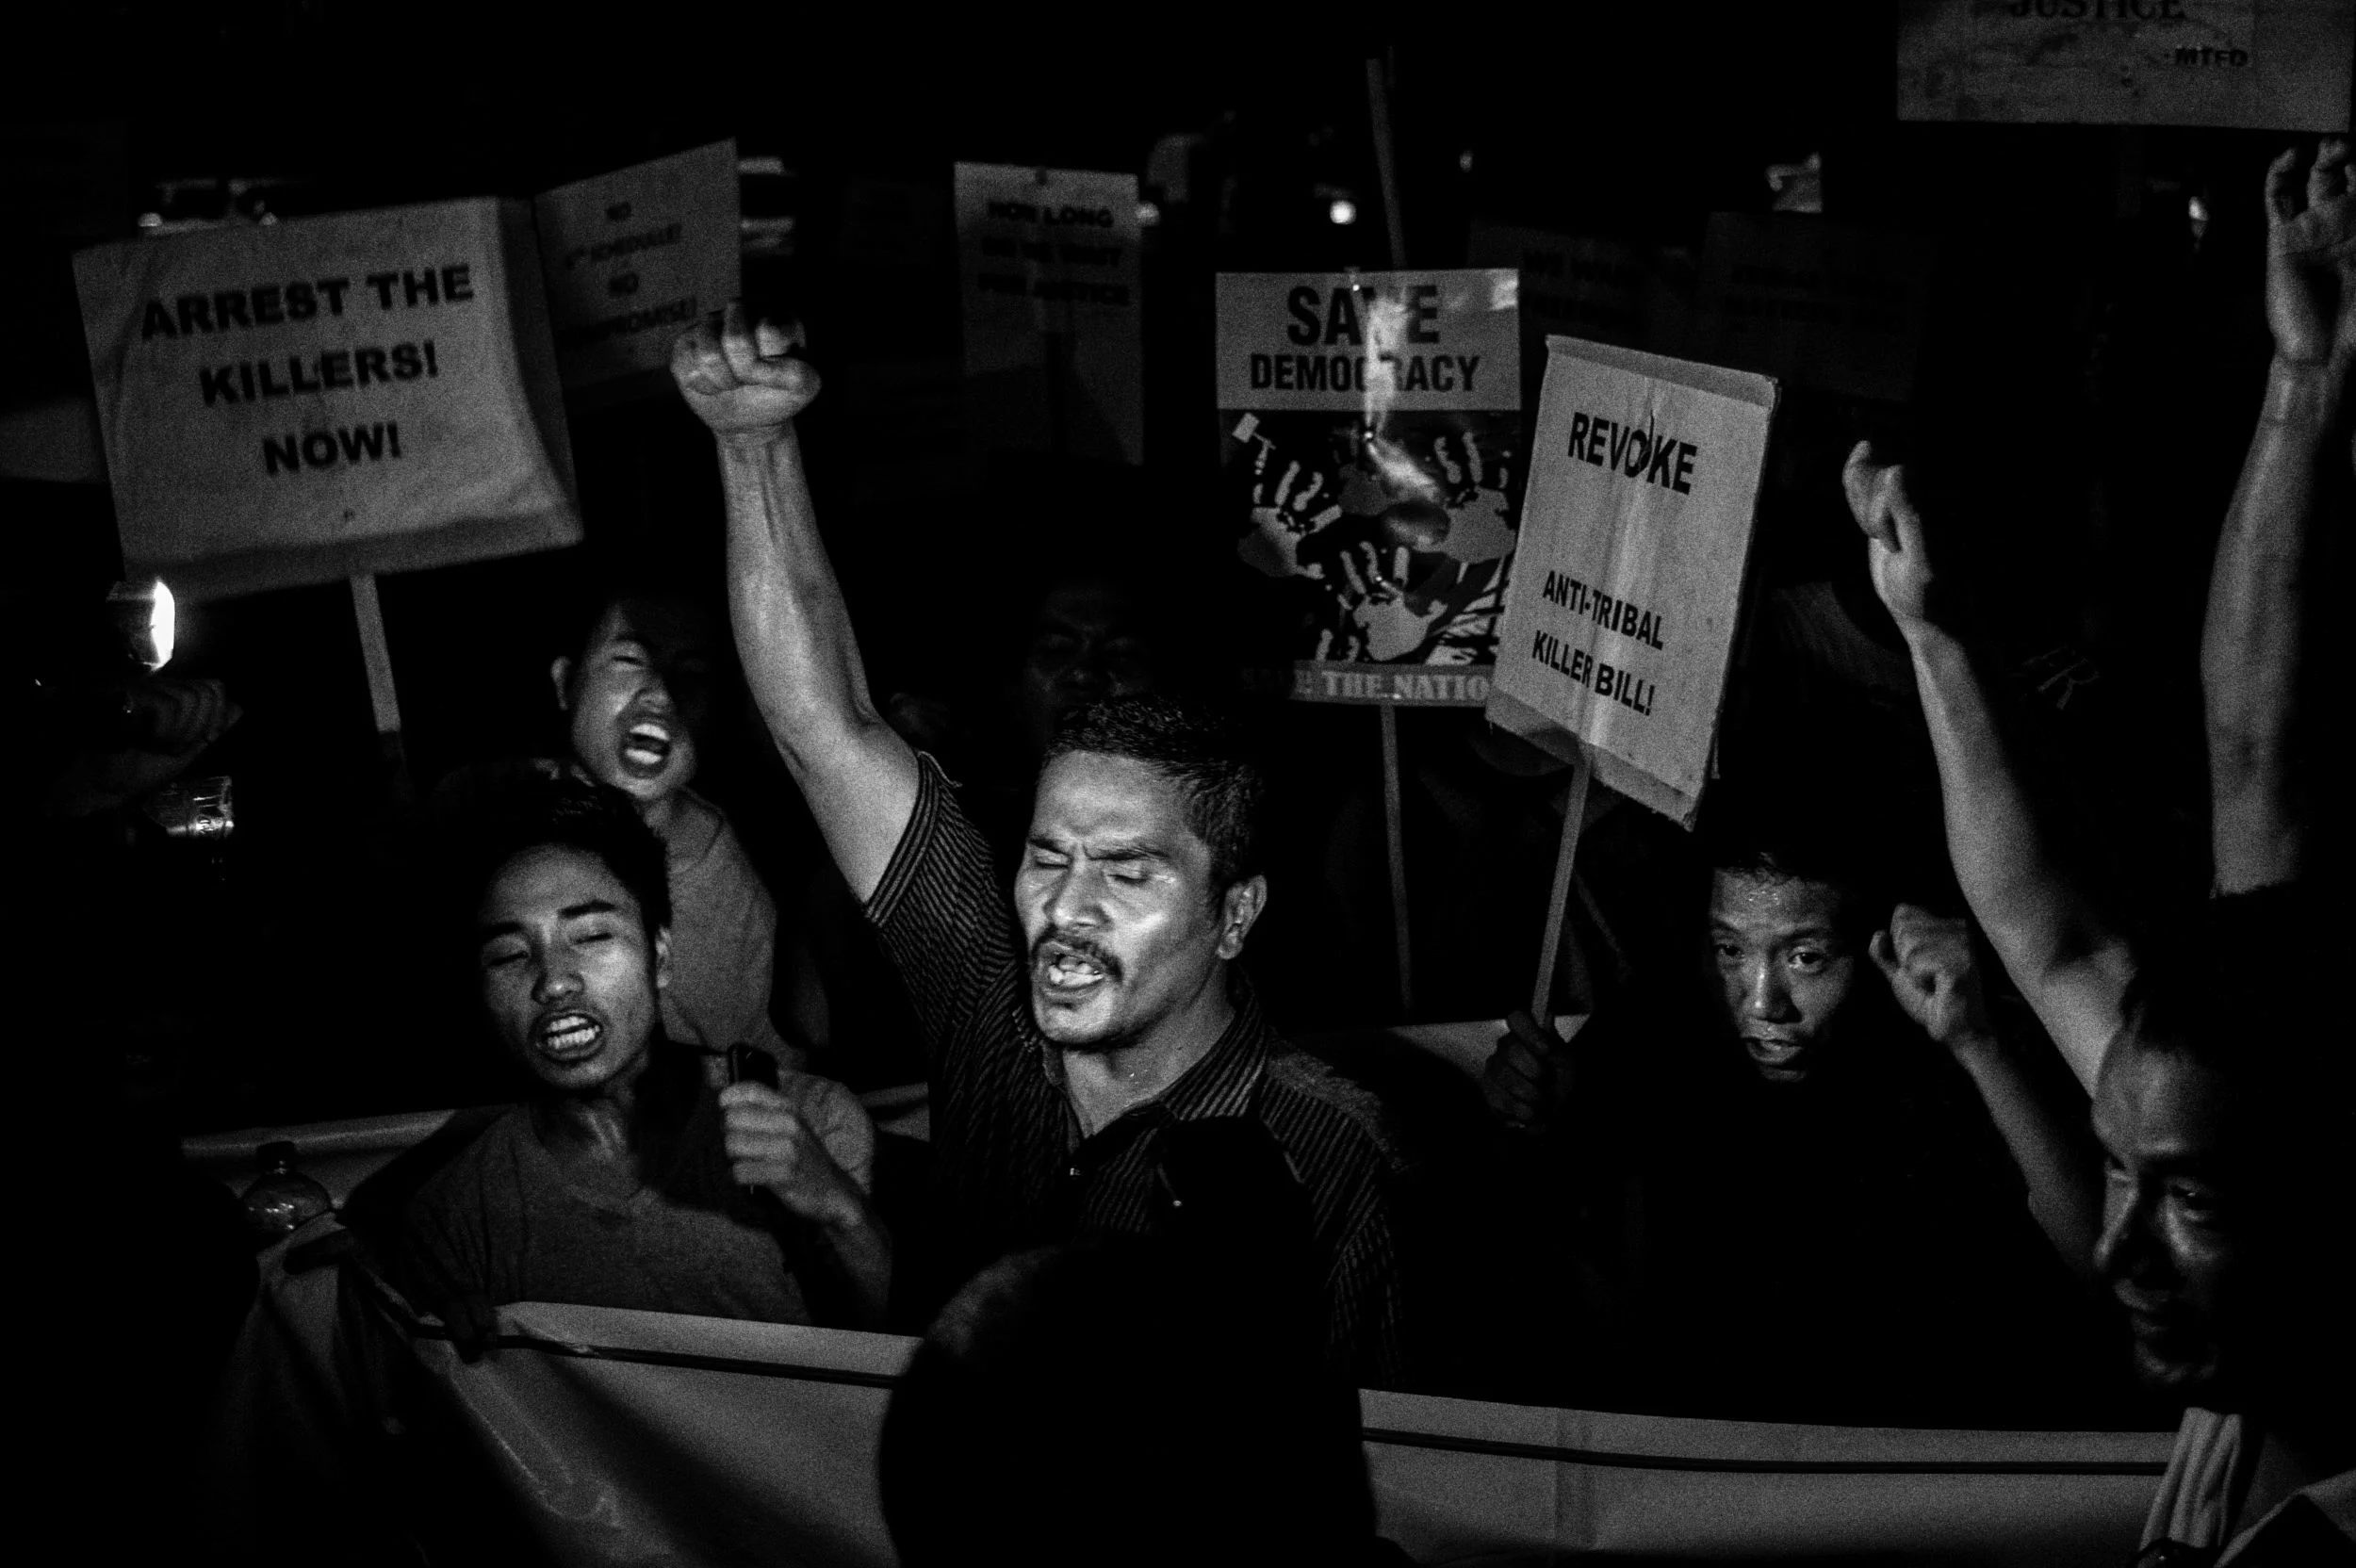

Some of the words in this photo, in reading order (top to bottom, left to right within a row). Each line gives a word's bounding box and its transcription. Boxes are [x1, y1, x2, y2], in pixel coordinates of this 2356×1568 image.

[606, 202, 631, 222] NO
[1044, 205, 1114, 229] LONG
[141, 280, 350, 340] ARREST
[368, 264, 473, 310] THE
[610, 272, 639, 298] NO
[1287, 286, 1440, 346] SAE
[200, 340, 439, 406] KILLERS!
[263, 422, 401, 476] NOW!
[1568, 412, 1697, 495] REVOKE
[1543, 571, 1663, 650] ANTI-TRIBAL
[1321, 670, 1383, 698] THE
[1531, 630, 1593, 688] KILLER
[1595, 663, 1656, 716] BILL!
